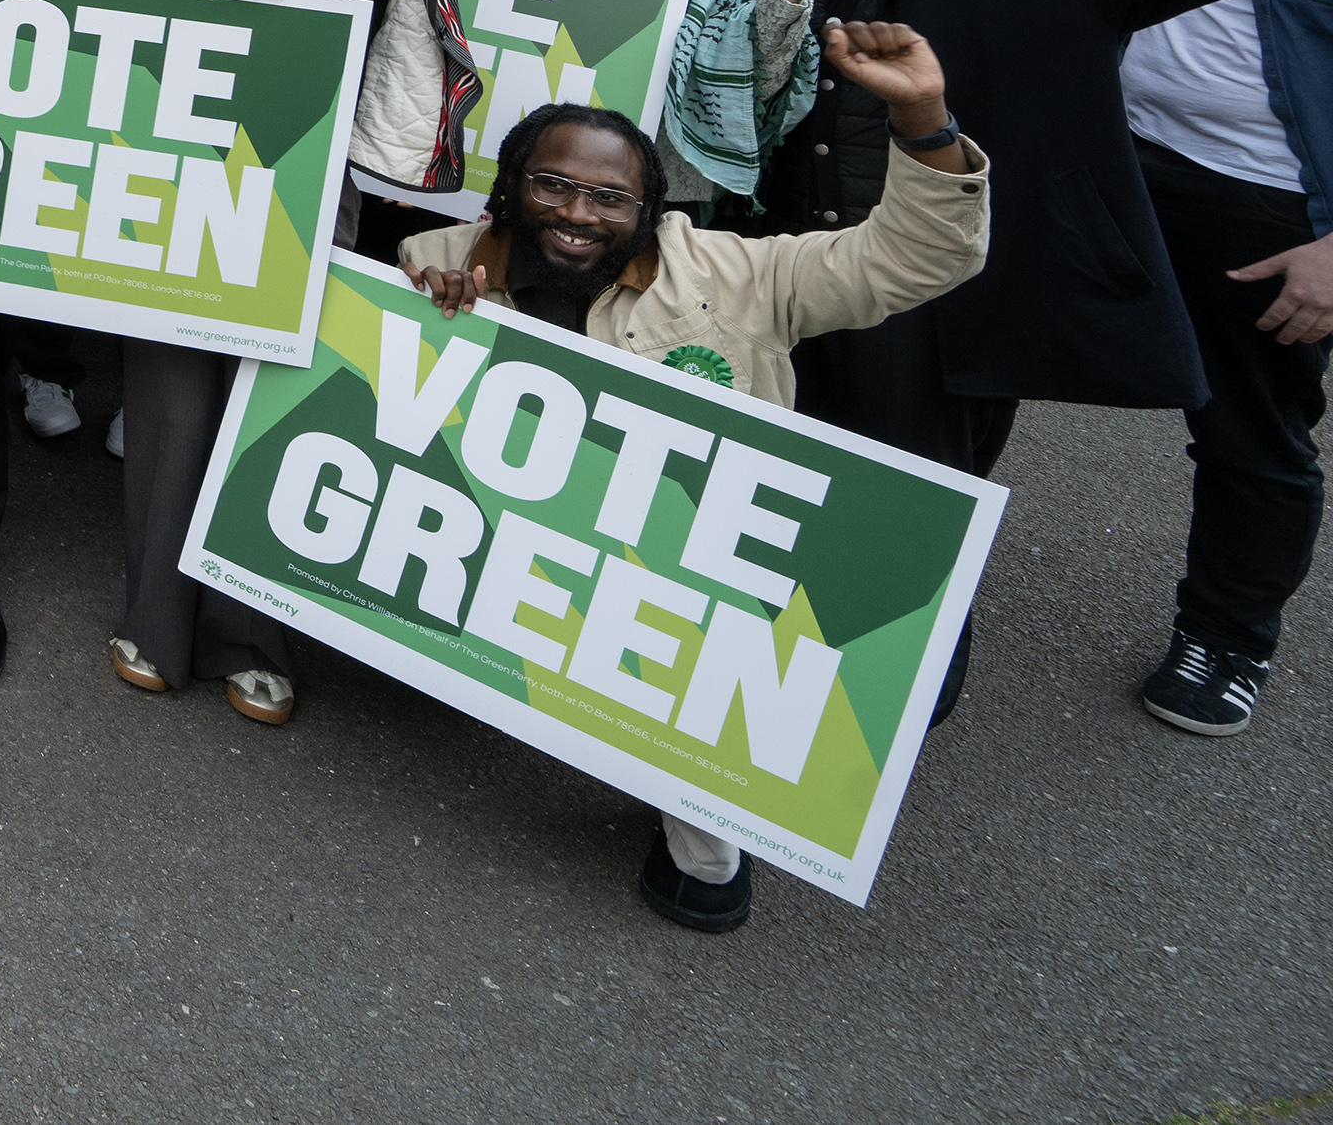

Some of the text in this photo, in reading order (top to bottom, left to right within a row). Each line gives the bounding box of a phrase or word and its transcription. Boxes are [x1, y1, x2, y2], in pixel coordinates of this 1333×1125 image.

[0, 257, 15, 266] The
[15, 259, 39, 271] Green
[63, 267, 83, 278] both
[83, 272, 92, 280] at
[93, 272, 105, 282] PO
[106, 275, 121, 285] Box
[150, 282, 182, 295] London
[182, 288, 202, 299] SE16
[203, 291, 222, 303] 9GQ
[175, 325, 296, 356] www.greenparty.org.uk
[375, 311, 832, 610] VOTE
[224, 573, 299, 619] Green Party
[266, 432, 844, 785] GREEN
[287, 562, 331, 589] Promoted
[329, 583, 342, 597] by
[342, 588, 367, 607] Chris
[367, 600, 405, 624] Williams
[405, 620, 418, 631] on
[418, 624, 450, 646] behalf
[449, 638, 461, 651] of
[461, 644, 480, 660] The
[480, 653, 511, 674] Green
[540, 681, 565, 700] both
[565, 694, 578, 706] at
[577, 699, 595, 714] PO
[594, 707, 615, 724] Box
[652, 734, 695, 762] London
[694, 754, 722, 775] SE16
[722, 767, 750, 788] 9GQ
[678, 795, 847, 886] www.greenparty.org.uk
